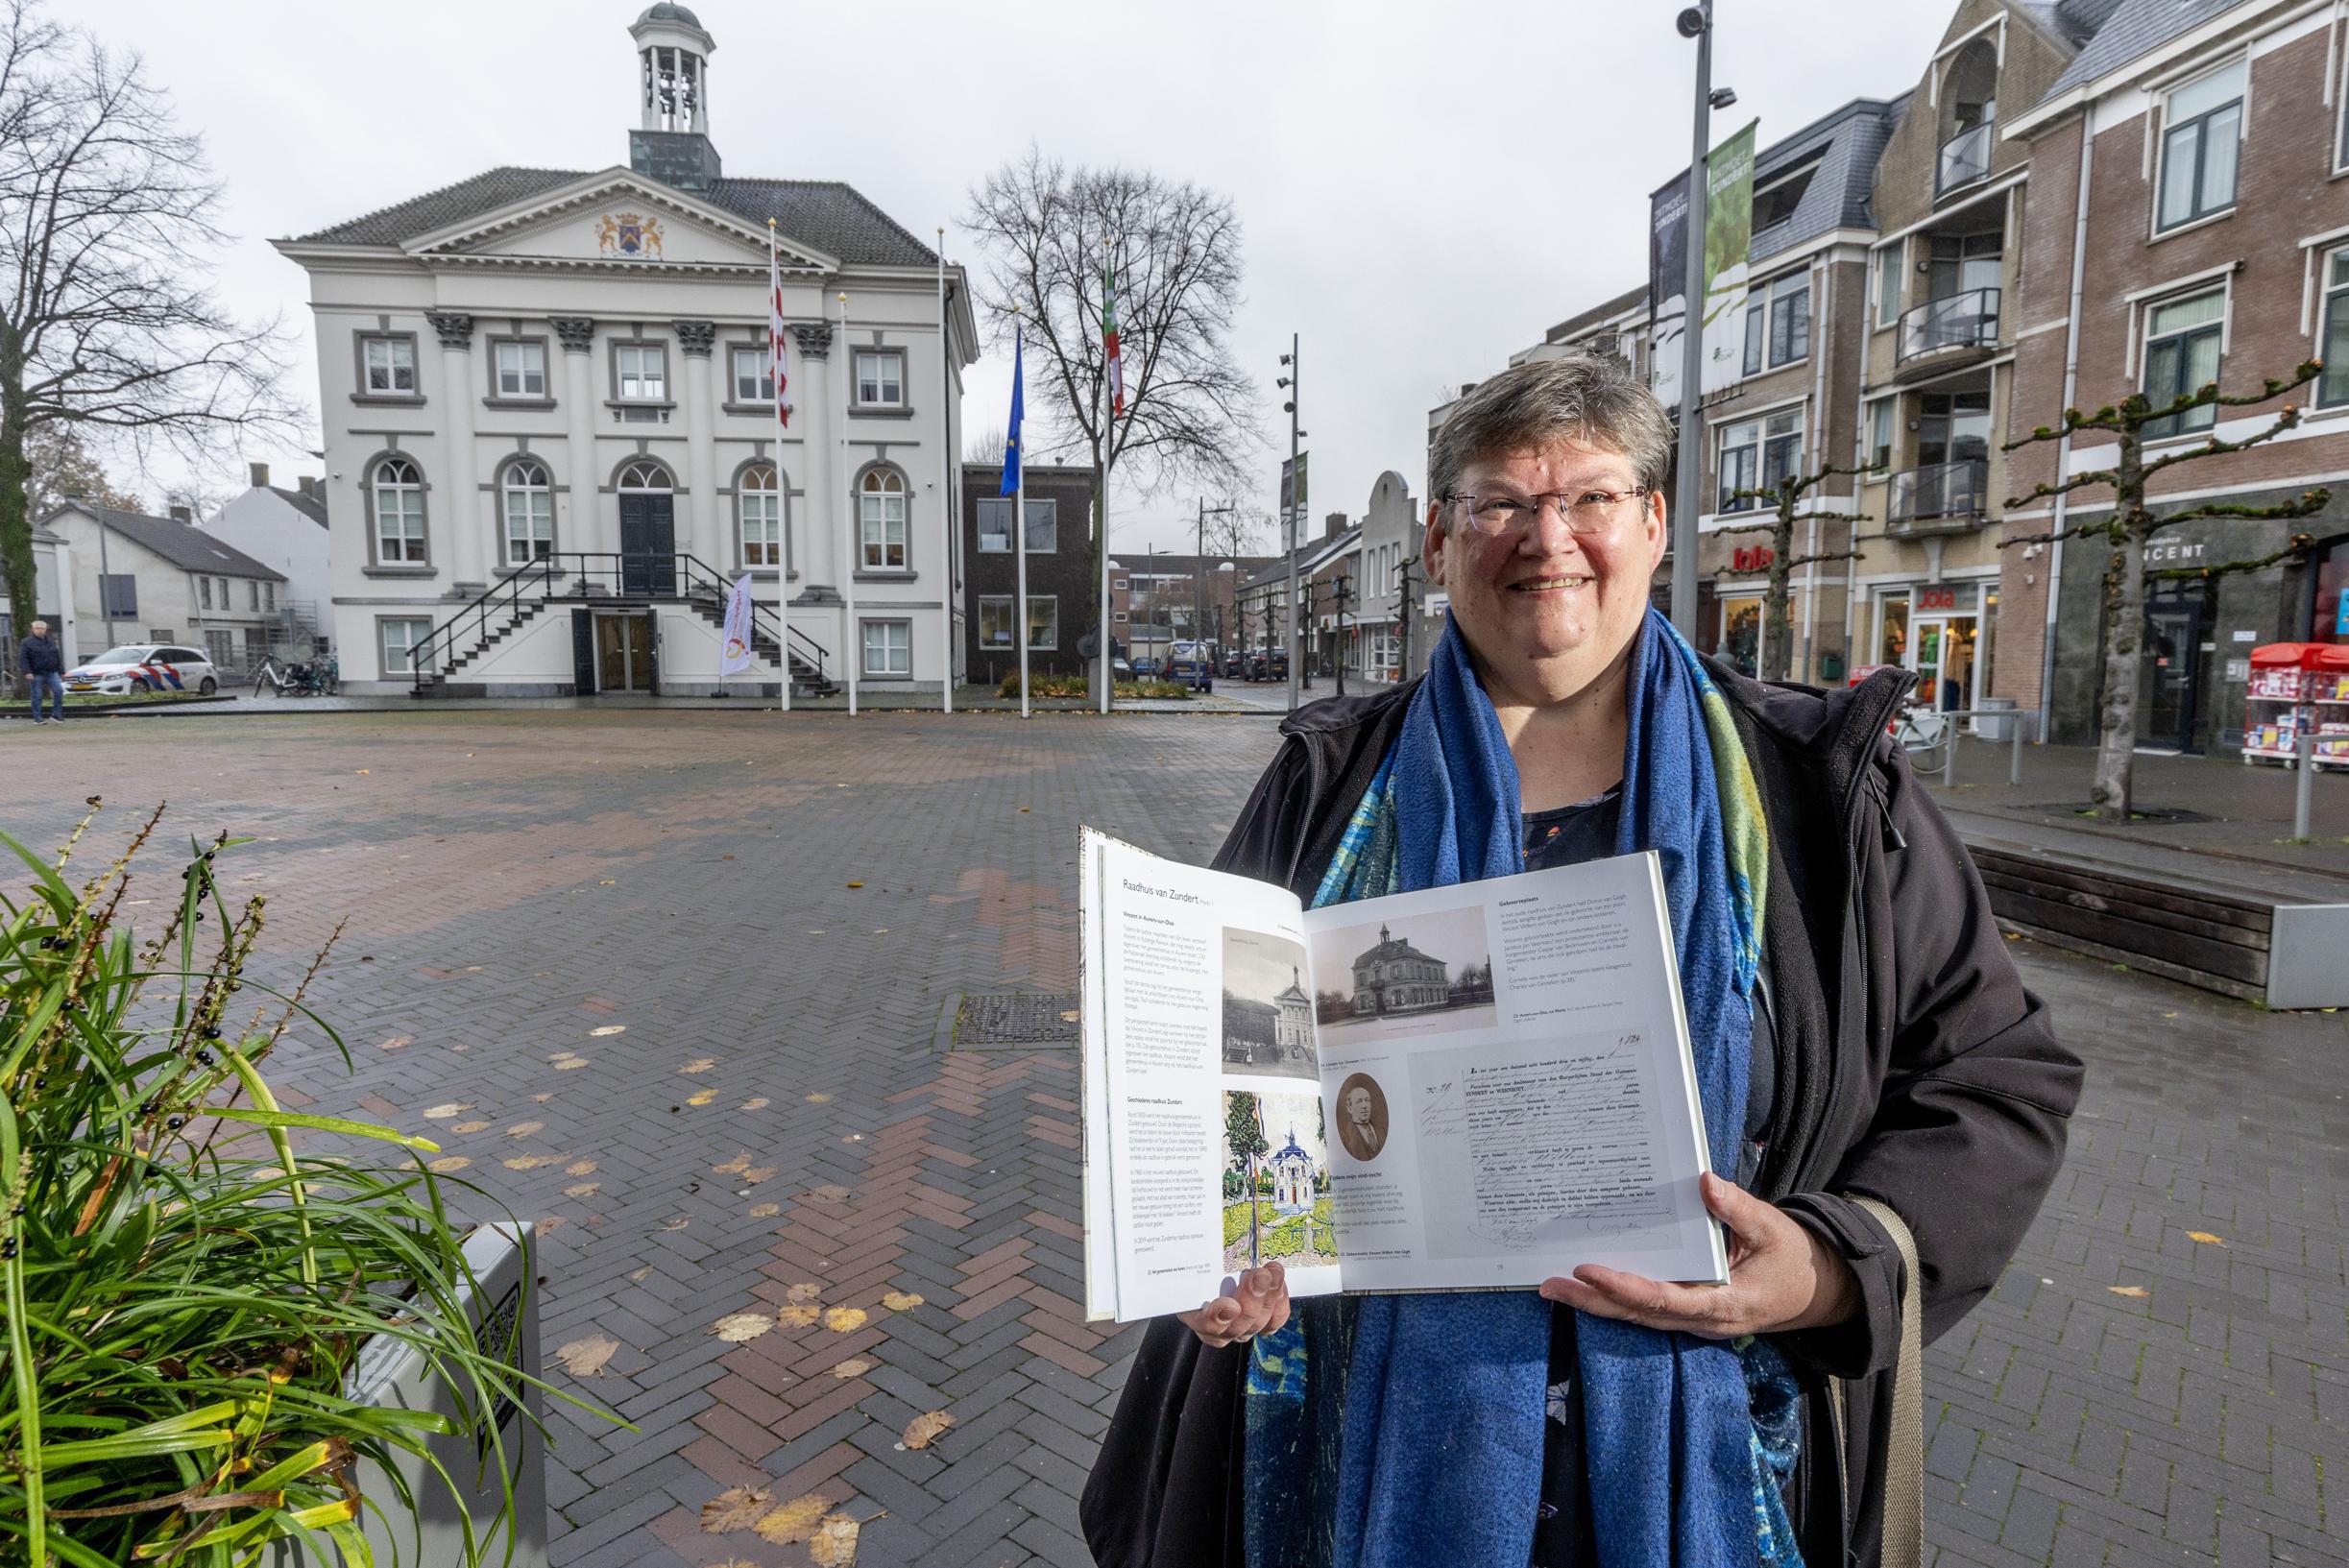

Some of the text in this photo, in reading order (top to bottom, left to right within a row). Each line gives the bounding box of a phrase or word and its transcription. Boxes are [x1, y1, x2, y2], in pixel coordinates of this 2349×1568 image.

[1917, 588, 1954, 609] Jola
[1123, 879, 1154, 896] Raadhuis
[1155, 889, 1168, 898] van
[1169, 888, 1199, 905] Zundert
[1498, 897, 1538, 906] Geboorteplaats
[1123, 910, 1138, 919] Vincent
[1126, 1096, 1151, 1104] Geschiedenis
